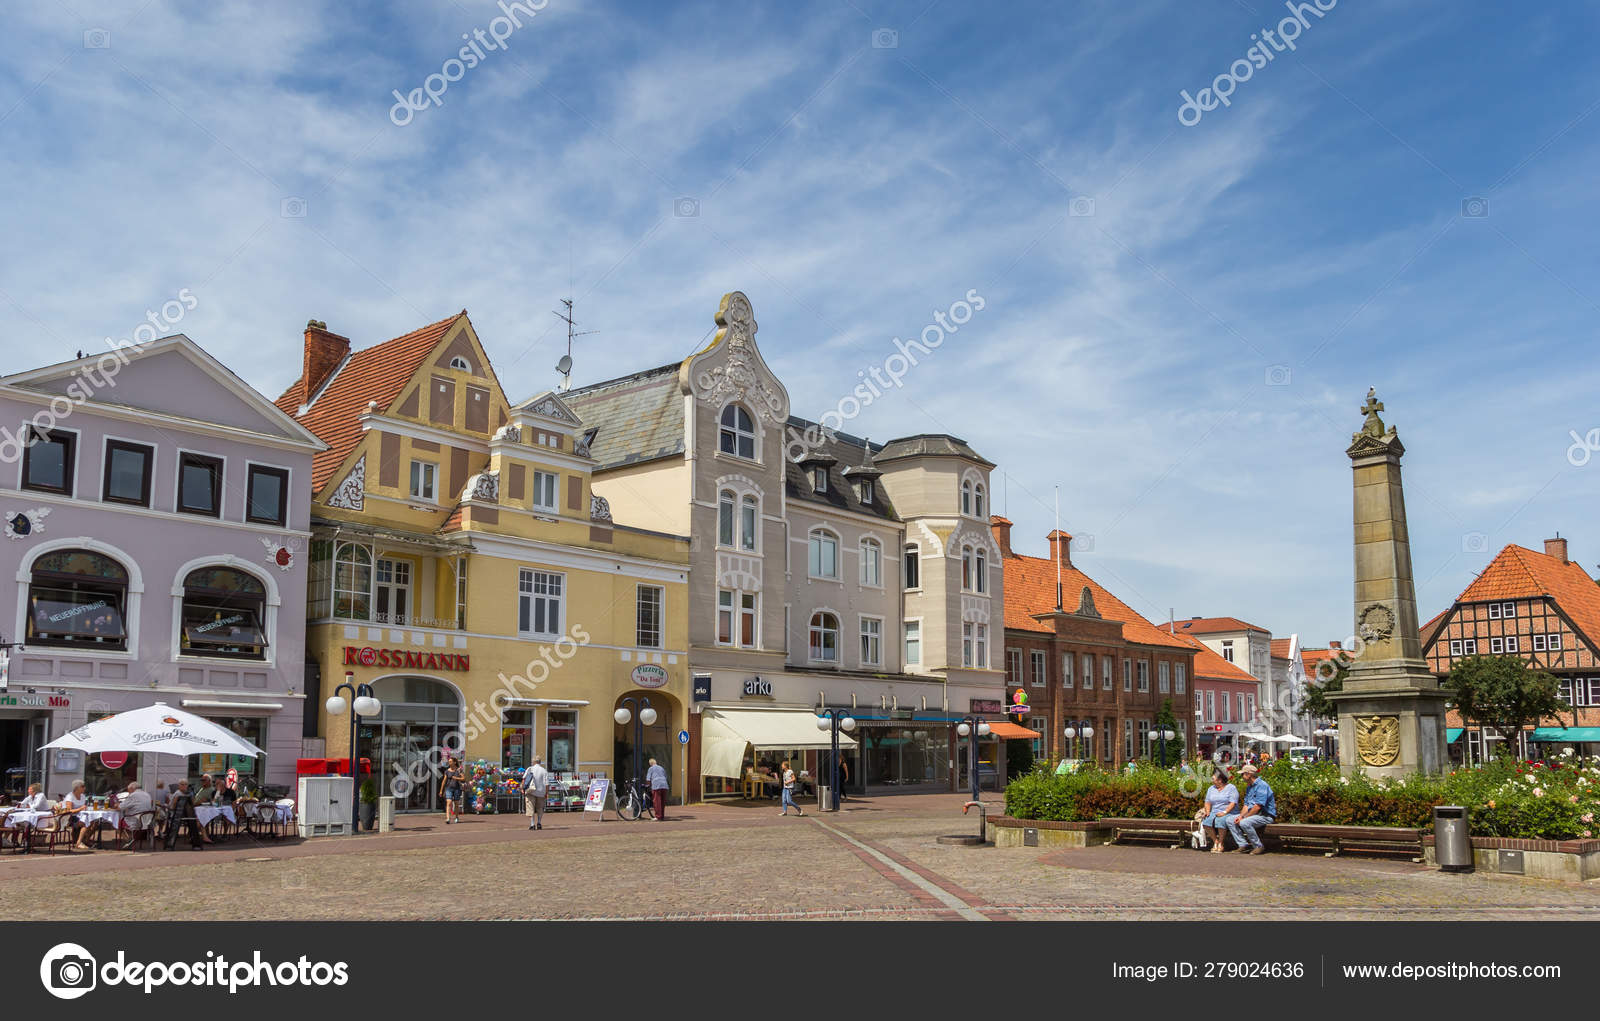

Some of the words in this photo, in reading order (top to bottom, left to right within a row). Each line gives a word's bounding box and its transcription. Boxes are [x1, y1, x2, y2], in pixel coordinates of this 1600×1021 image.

[342, 646, 470, 673] ROSSMANN
[744, 676, 773, 696] arko
[21, 696, 46, 706] Sole
[48, 696, 70, 707] Mio
